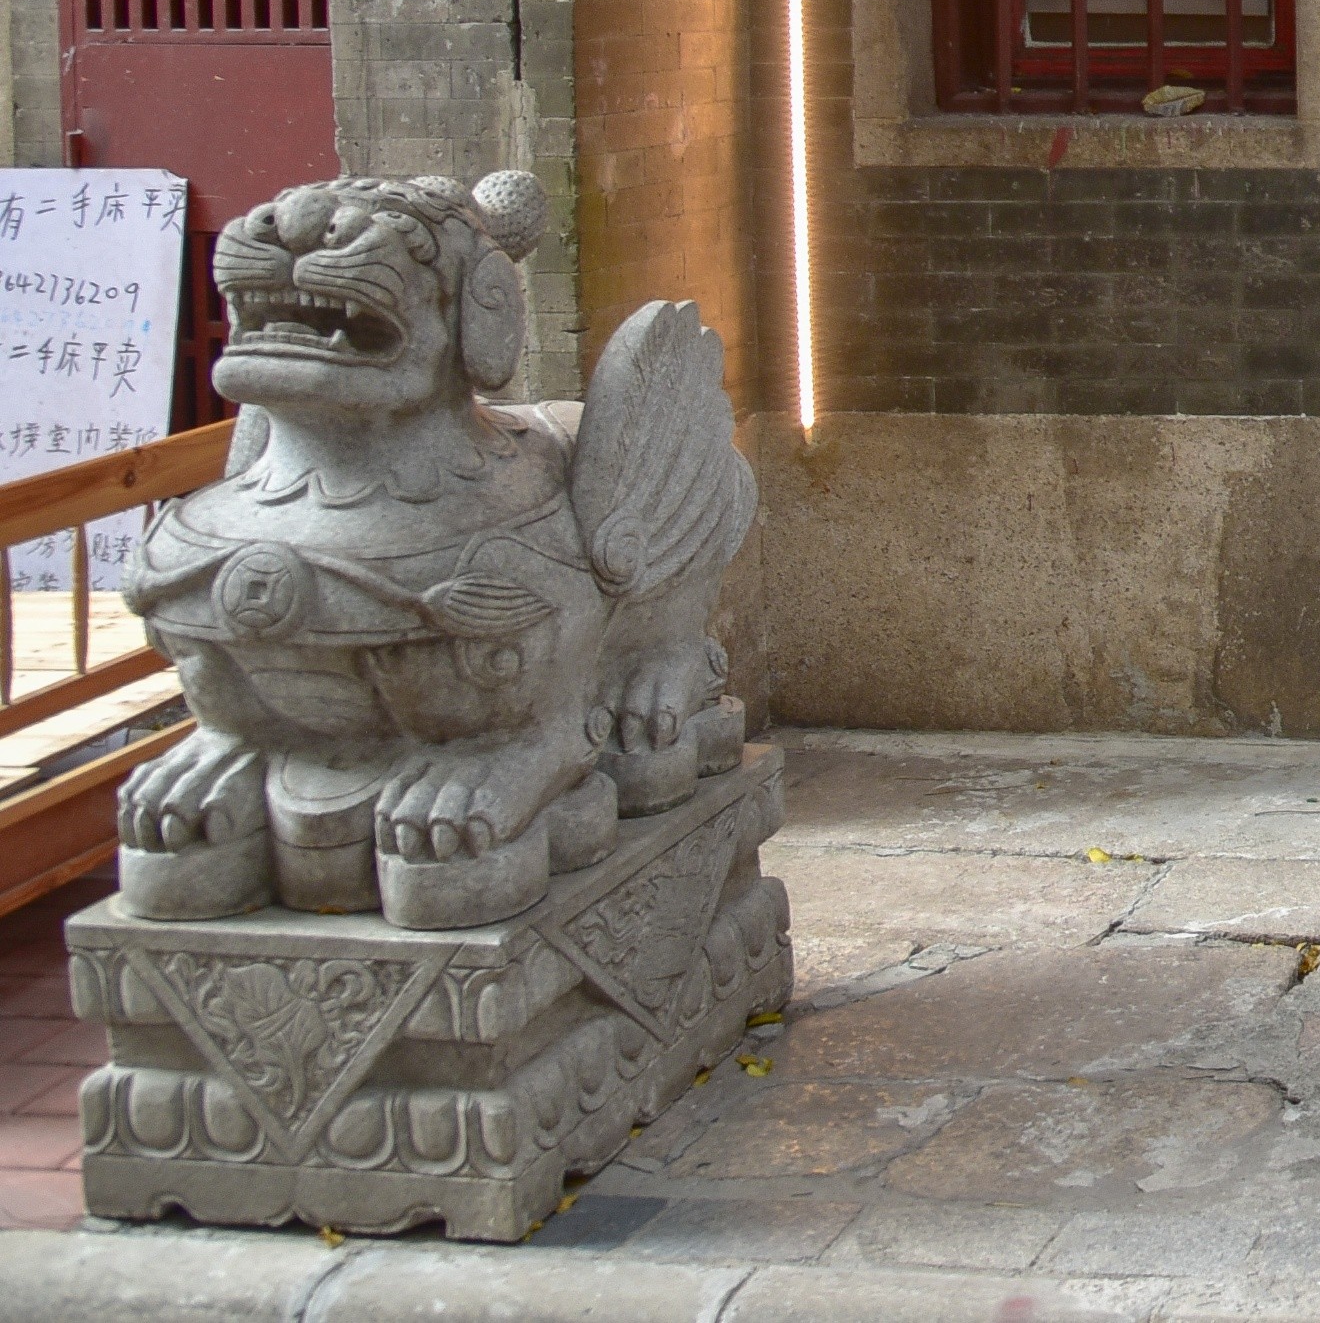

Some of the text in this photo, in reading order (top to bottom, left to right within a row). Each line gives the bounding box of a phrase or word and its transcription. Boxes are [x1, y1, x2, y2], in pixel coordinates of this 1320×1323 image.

[0, 270, 140, 314] 642736209
[0, 332, 143, 399] 二手床平卖
